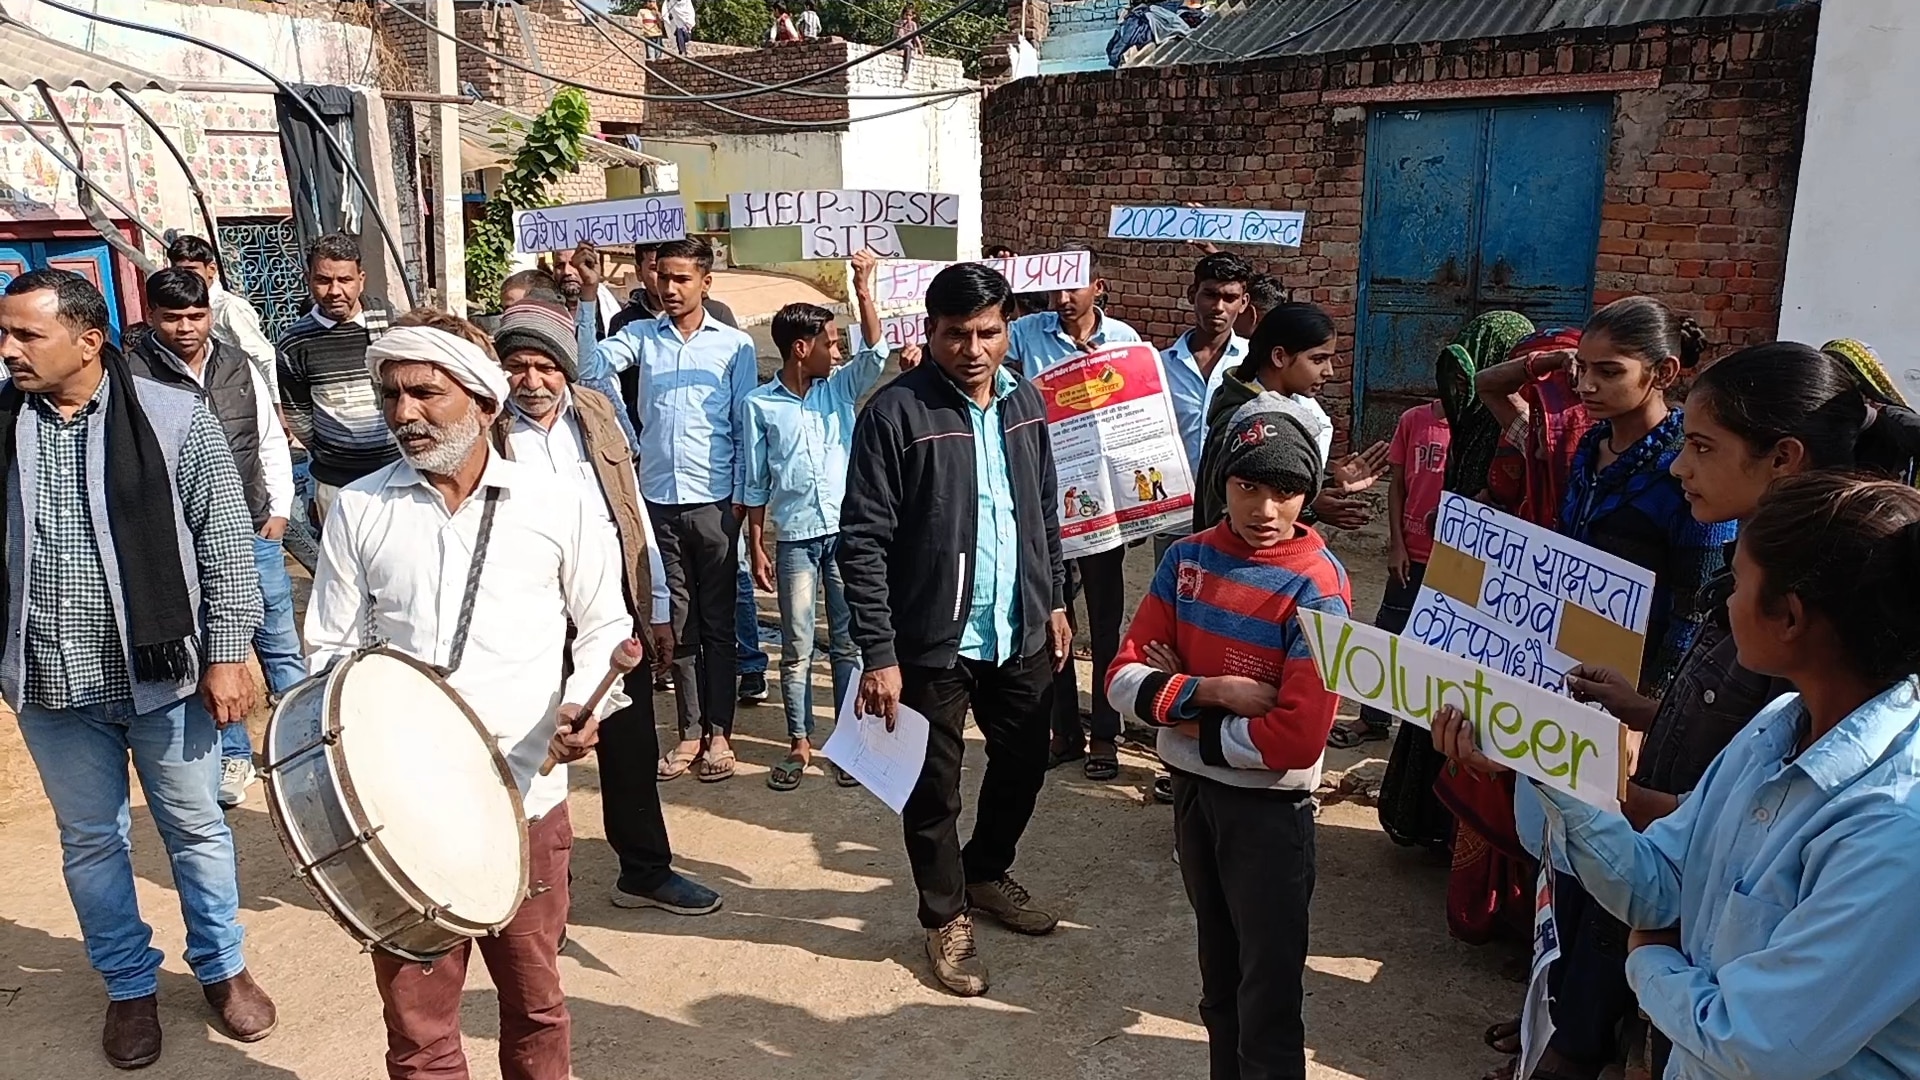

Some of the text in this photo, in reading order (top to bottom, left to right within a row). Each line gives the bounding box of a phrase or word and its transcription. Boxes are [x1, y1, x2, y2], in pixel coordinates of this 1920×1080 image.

[516, 211, 568, 251] विशेष
[1115, 207, 1178, 237] 2002
[1240, 211, 1302, 245] लिस्ट
[1020, 252, 1084, 289] प्रपत्र
[1531, 544, 1648, 631] साक्षरता
[1313, 611, 1600, 790] Volunteer
